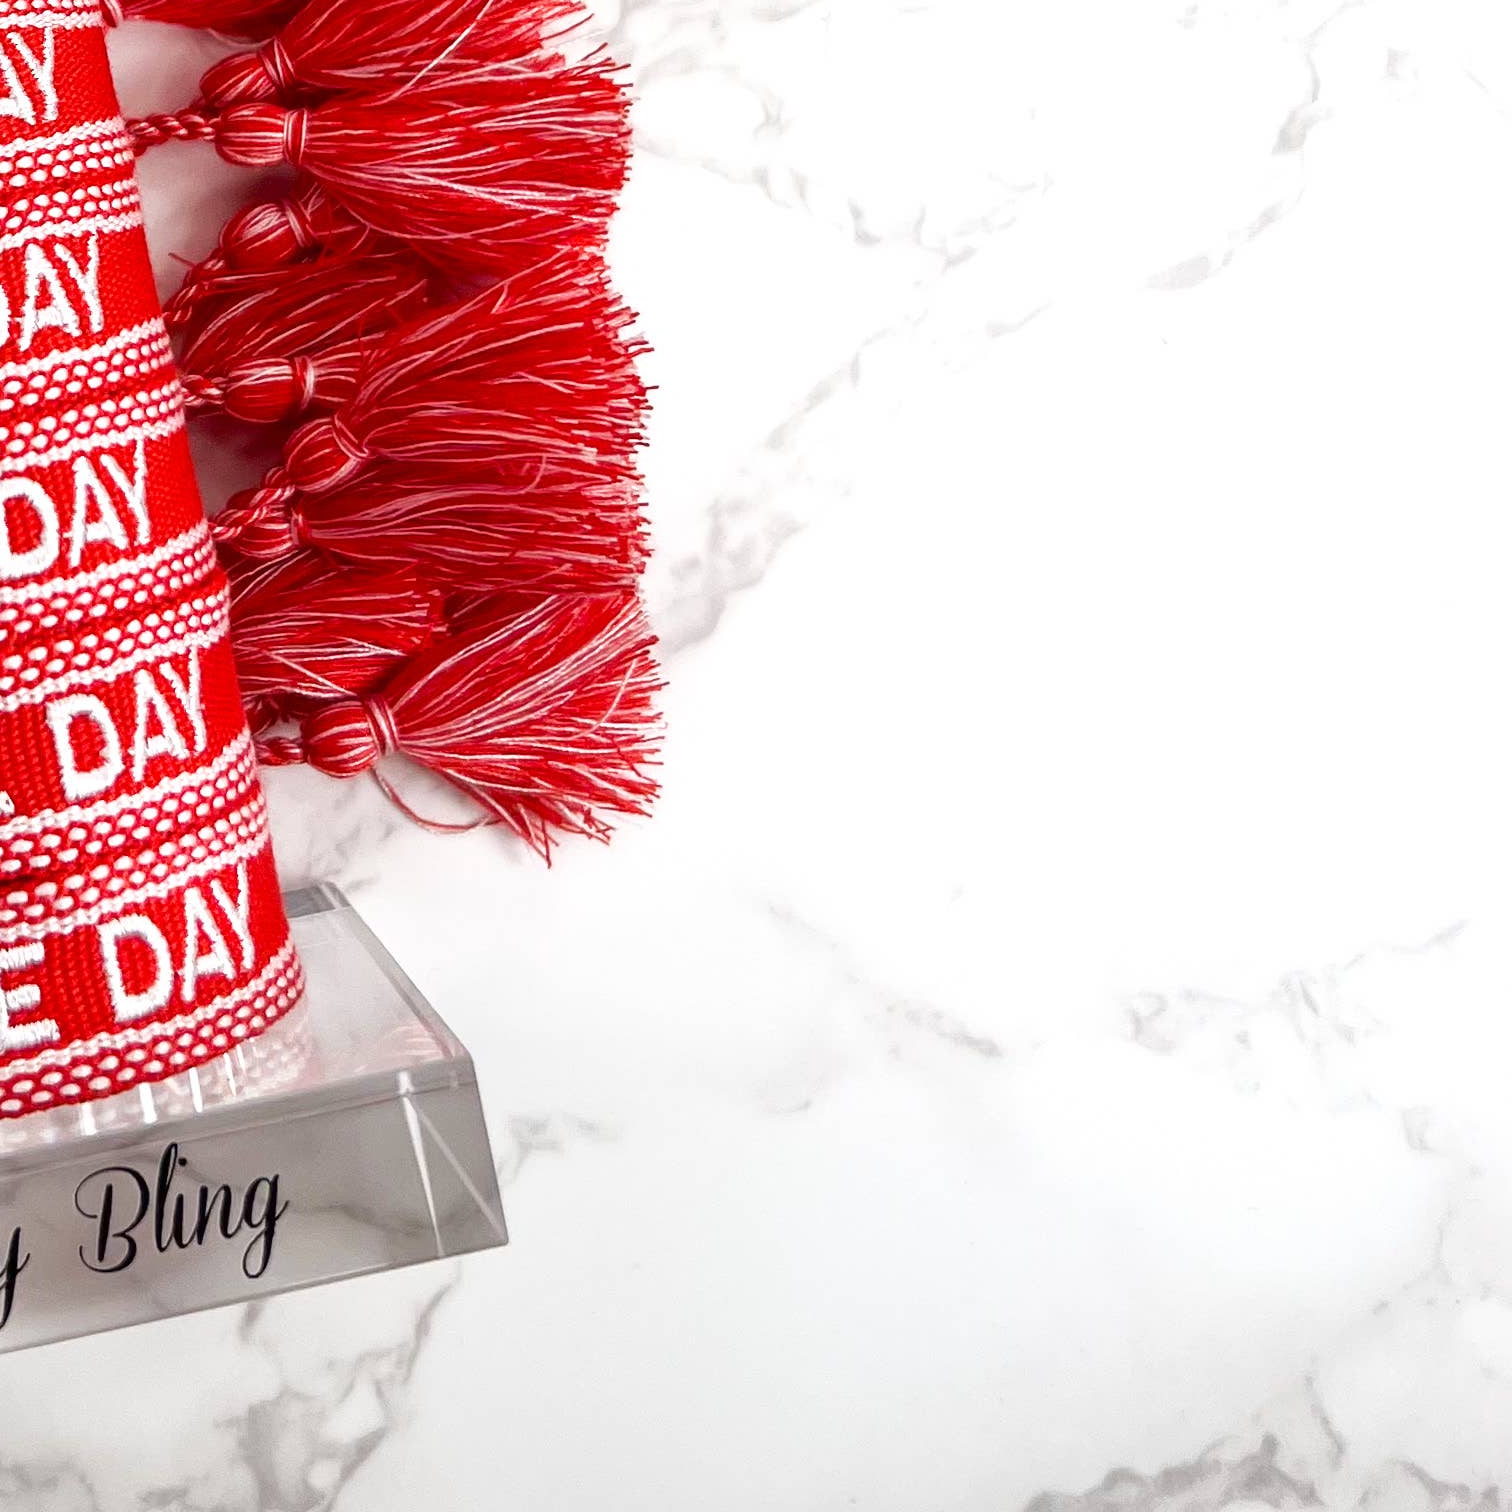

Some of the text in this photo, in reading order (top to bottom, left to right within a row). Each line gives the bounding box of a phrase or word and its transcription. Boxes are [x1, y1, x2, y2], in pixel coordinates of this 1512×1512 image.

[47, 645, 208, 799] DAY
[99, 865, 257, 1023] DAY
[74, 1143, 289, 1278] Bling
